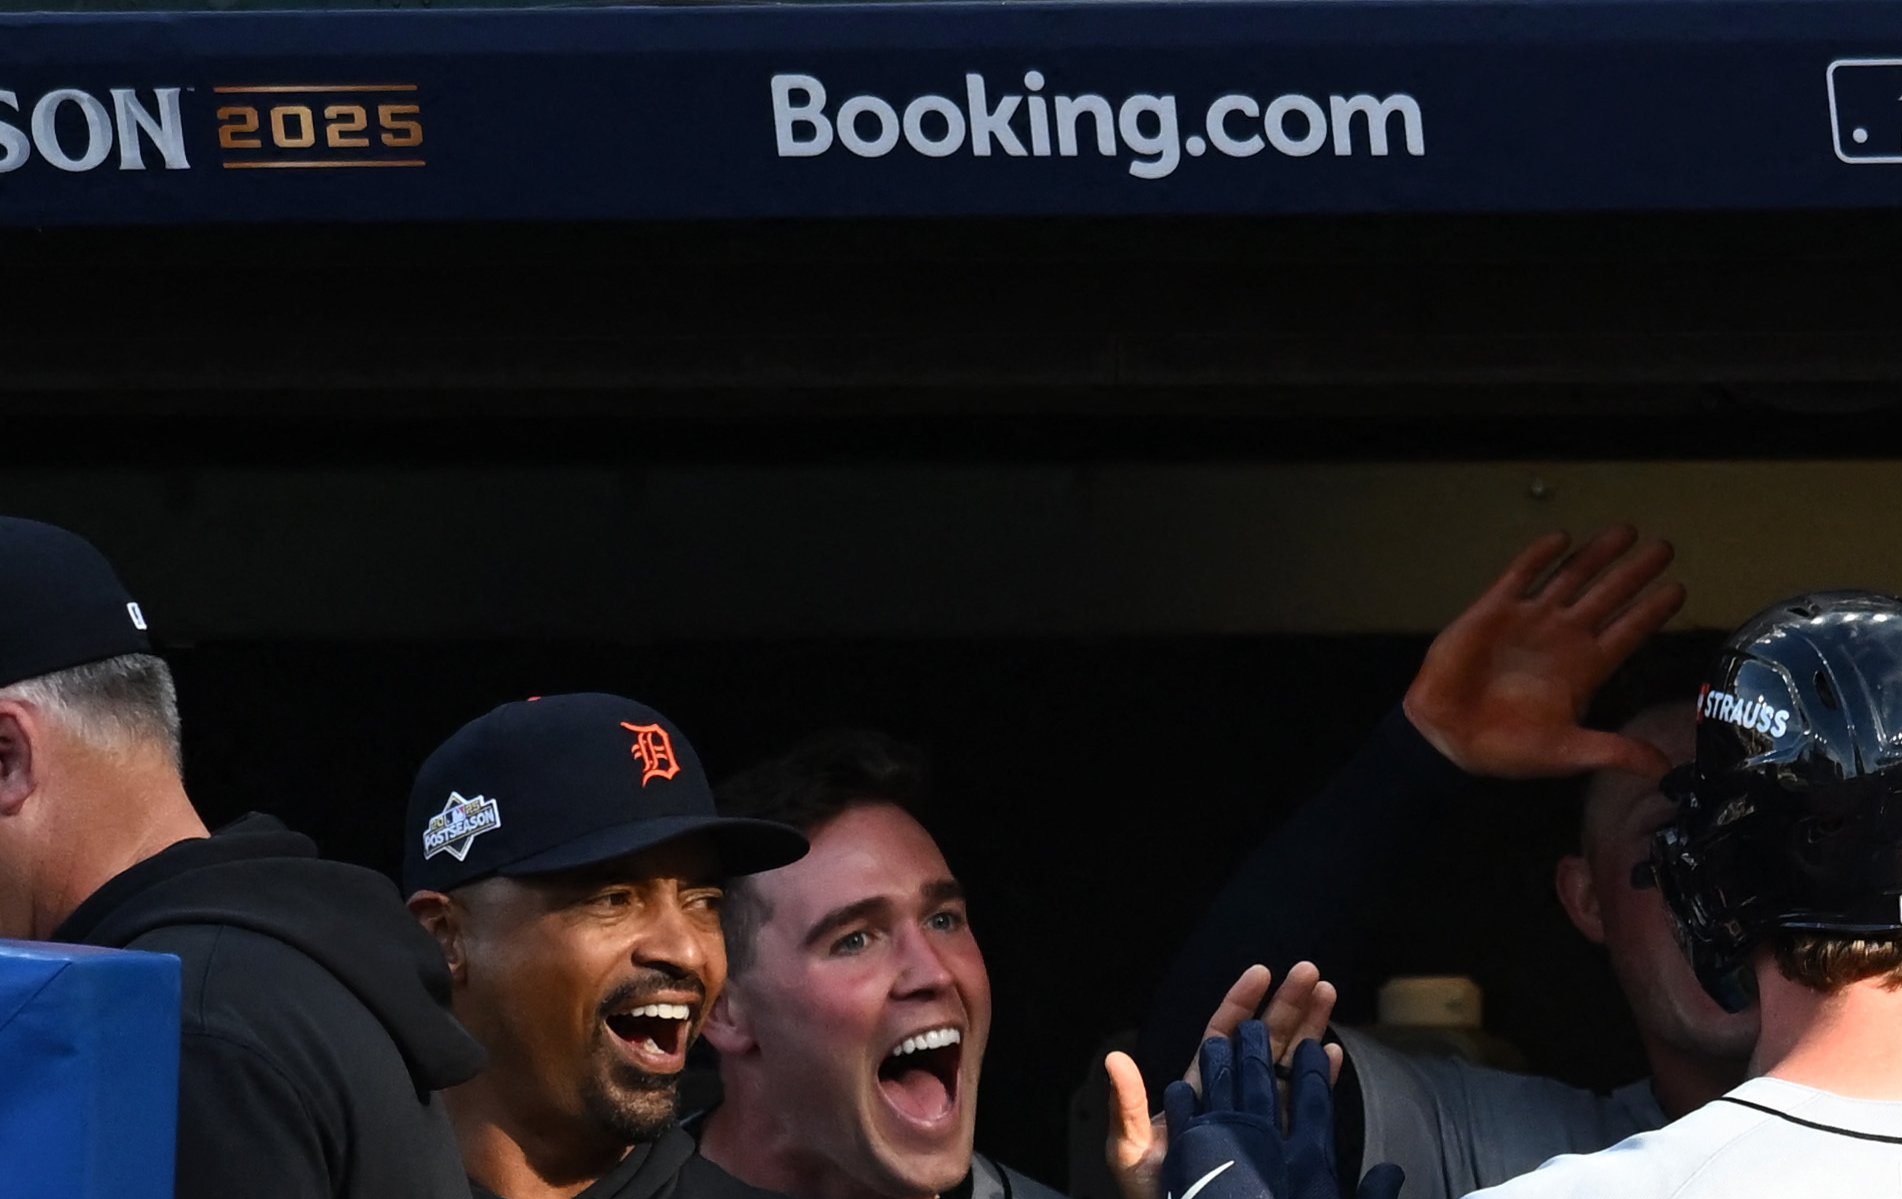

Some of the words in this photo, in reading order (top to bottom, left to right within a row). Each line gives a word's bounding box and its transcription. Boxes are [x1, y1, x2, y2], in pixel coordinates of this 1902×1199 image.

[217, 105, 425, 149] 2025
[770, 70, 1426, 180] Booking.com
[1704, 690, 1790, 738] STRAUSS
[620, 721, 681, 787] D
[424, 808, 495, 852] POSTSEASON
